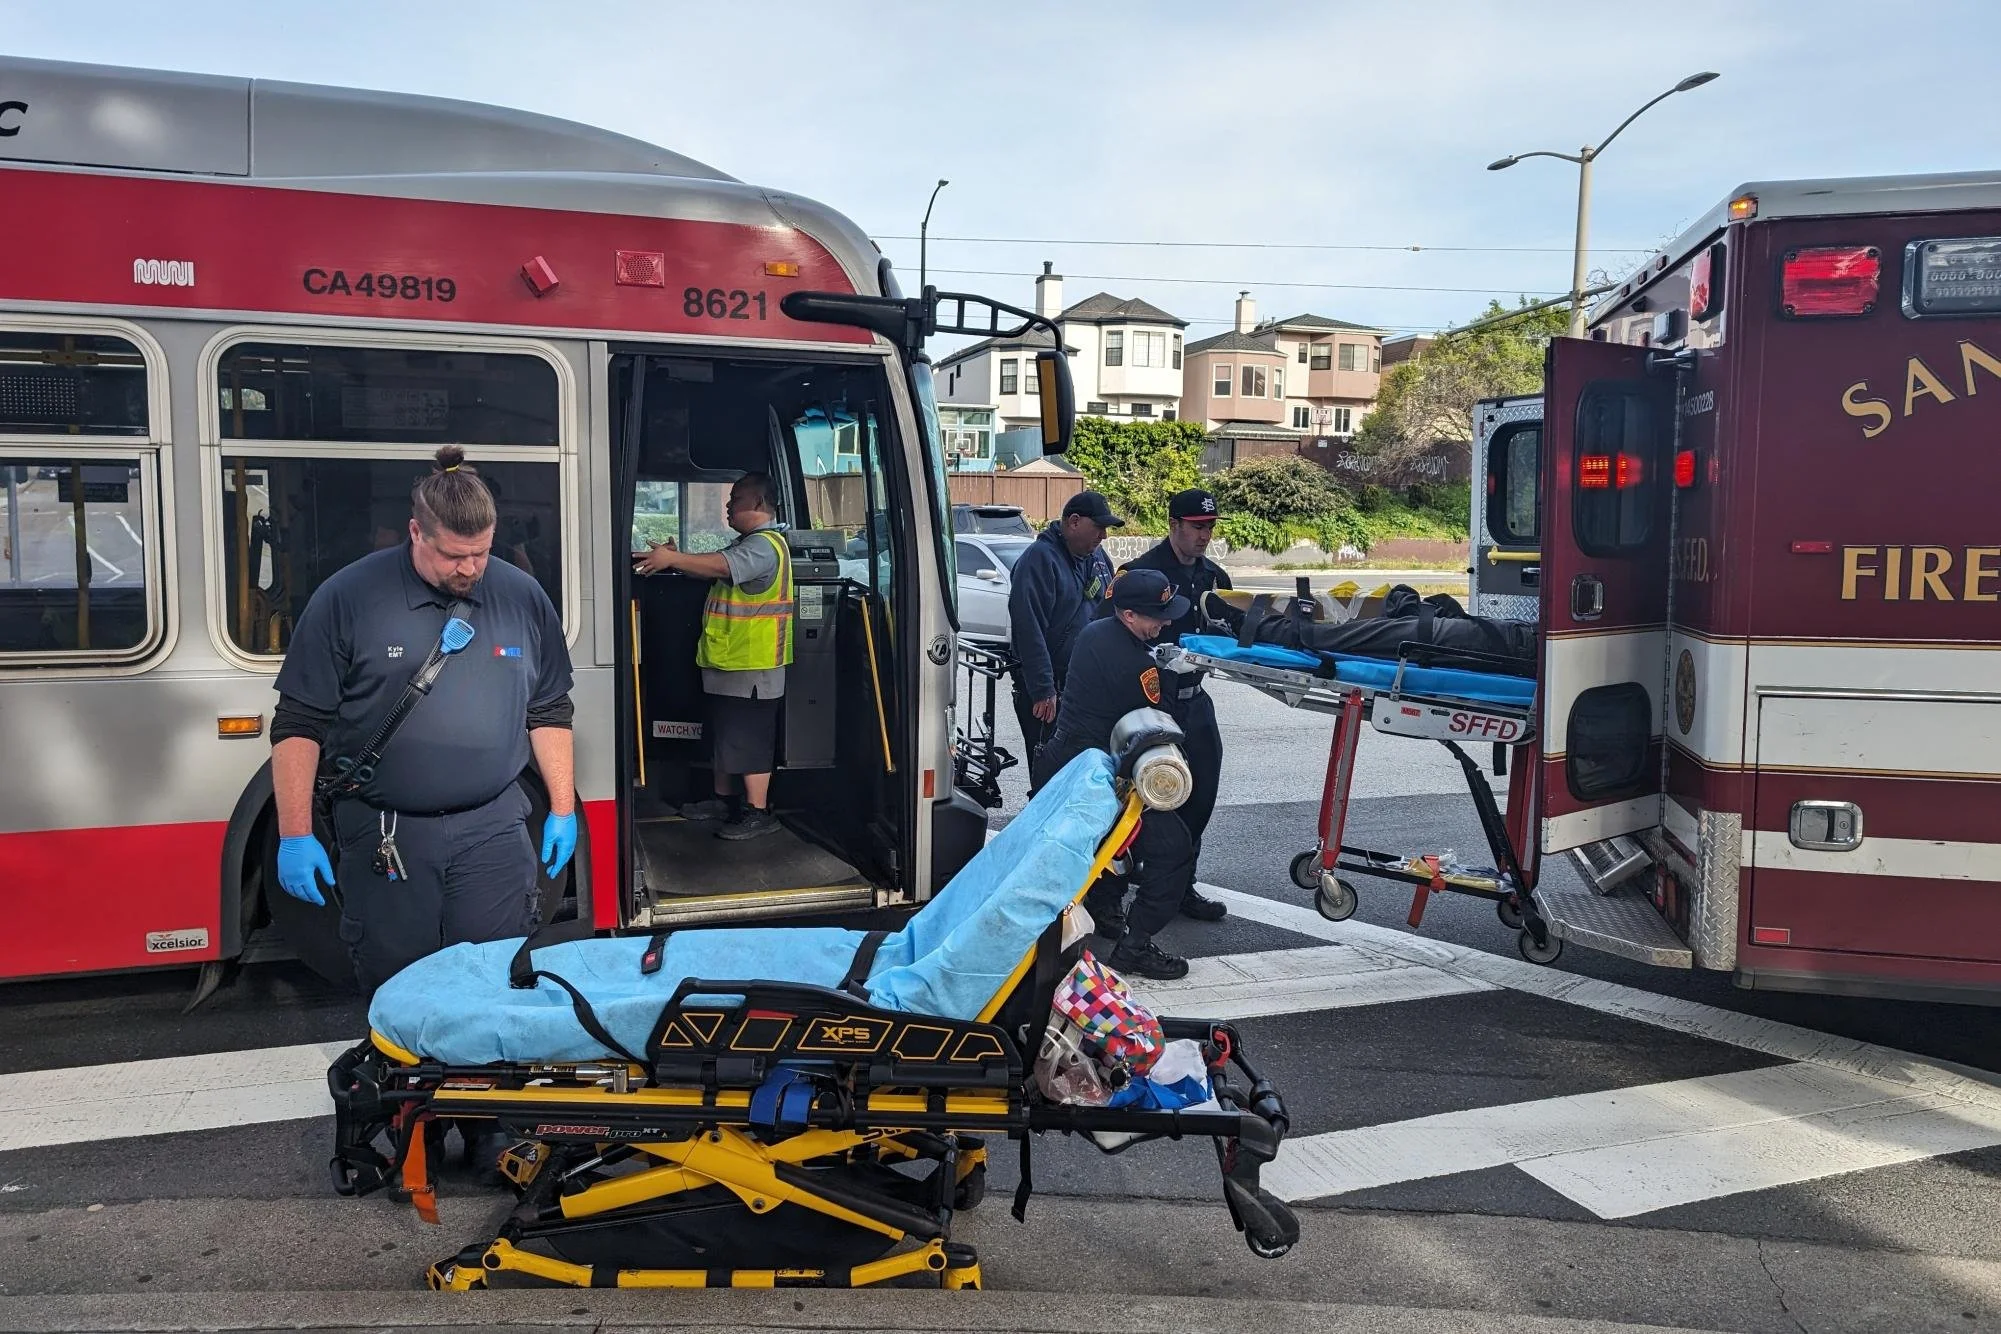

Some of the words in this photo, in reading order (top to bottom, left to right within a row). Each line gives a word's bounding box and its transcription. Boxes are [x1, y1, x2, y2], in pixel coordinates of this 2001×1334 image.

[134, 258, 194, 286] MUNI
[303, 268, 457, 302] CA49819
[683, 287, 767, 320] 8621
[1841, 545, 2001, 601] FIRE
[658, 725, 689, 735] WATCH
[1450, 712, 1518, 740] SFFD
[152, 937, 204, 950] xcelsior
[821, 1026, 870, 1041] XPS
[535, 1124, 610, 1136] power
